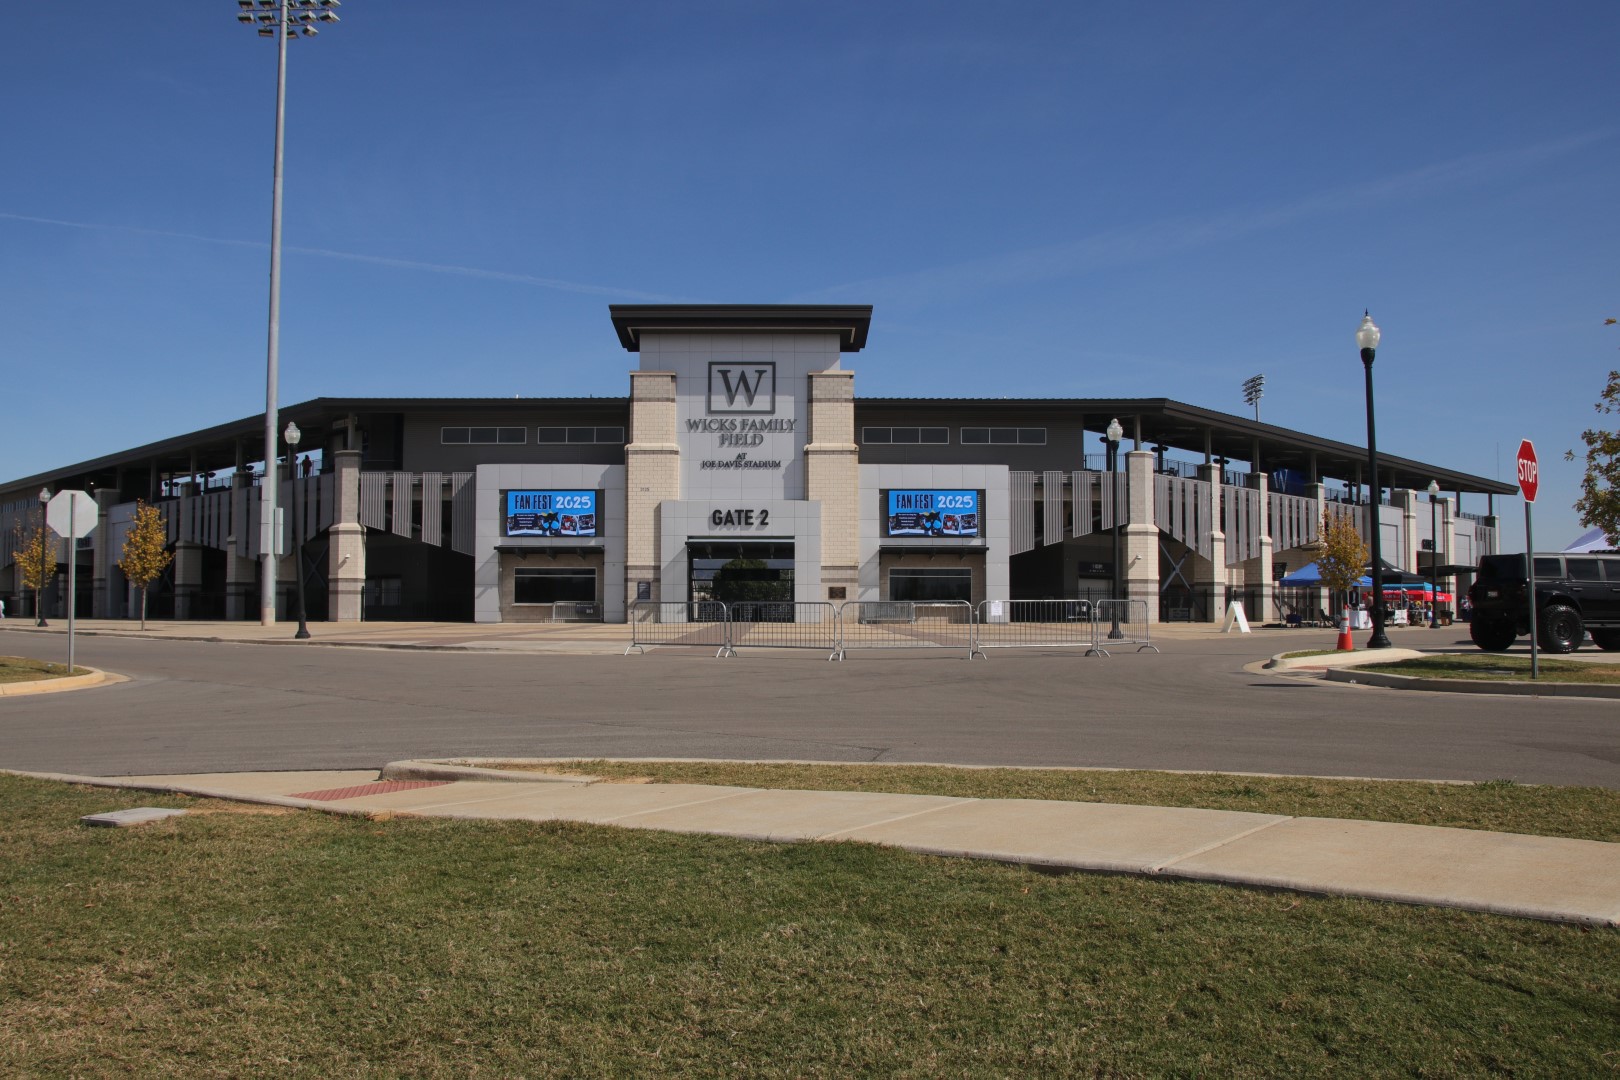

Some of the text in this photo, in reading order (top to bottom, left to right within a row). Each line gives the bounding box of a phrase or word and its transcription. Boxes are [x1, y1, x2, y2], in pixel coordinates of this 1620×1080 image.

[717, 369, 767, 406] W
[687, 418, 797, 431] WICKS FAMILY
[720, 433, 764, 446] FIELD
[736, 452, 747, 460] AT
[702, 460, 781, 469] JOE DAVIS STADIUM
[1518, 458, 1537, 483] STOP
[514, 494, 592, 510] FAN FEST 2025
[896, 494, 974, 509] FAN FEST 2025
[712, 509, 769, 526] GATE 2
